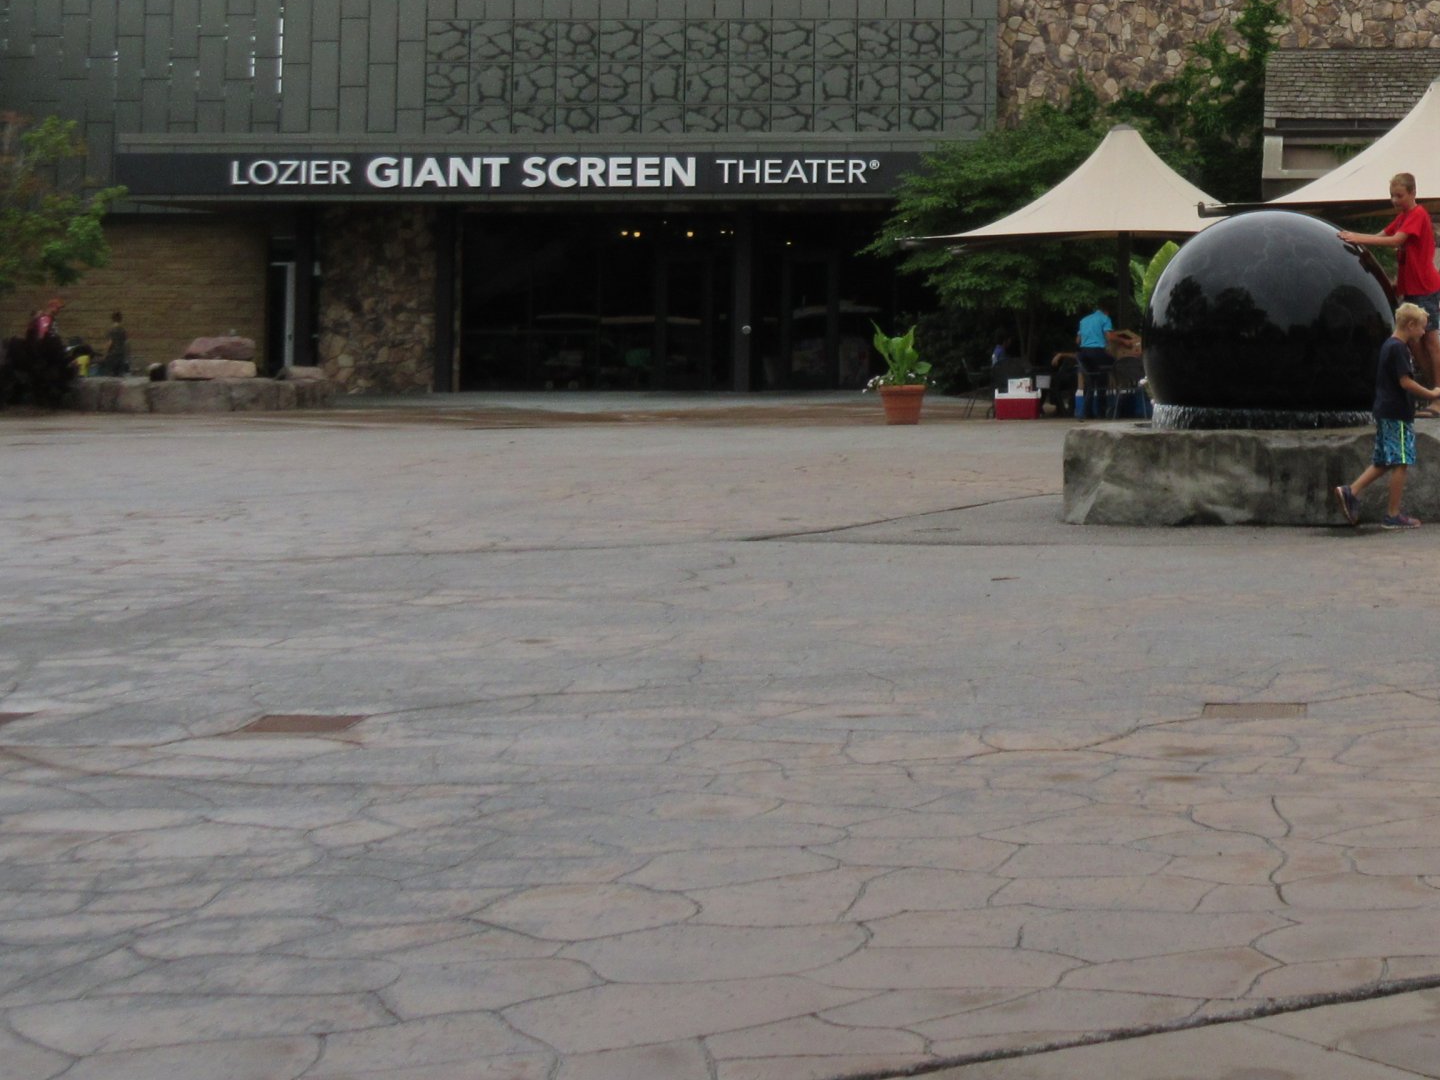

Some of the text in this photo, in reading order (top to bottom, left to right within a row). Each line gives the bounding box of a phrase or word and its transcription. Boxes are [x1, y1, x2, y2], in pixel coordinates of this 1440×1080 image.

[231, 160, 351, 185] LOZIER
[366, 156, 510, 188] GIANT
[521, 156, 697, 188] SCREEN
